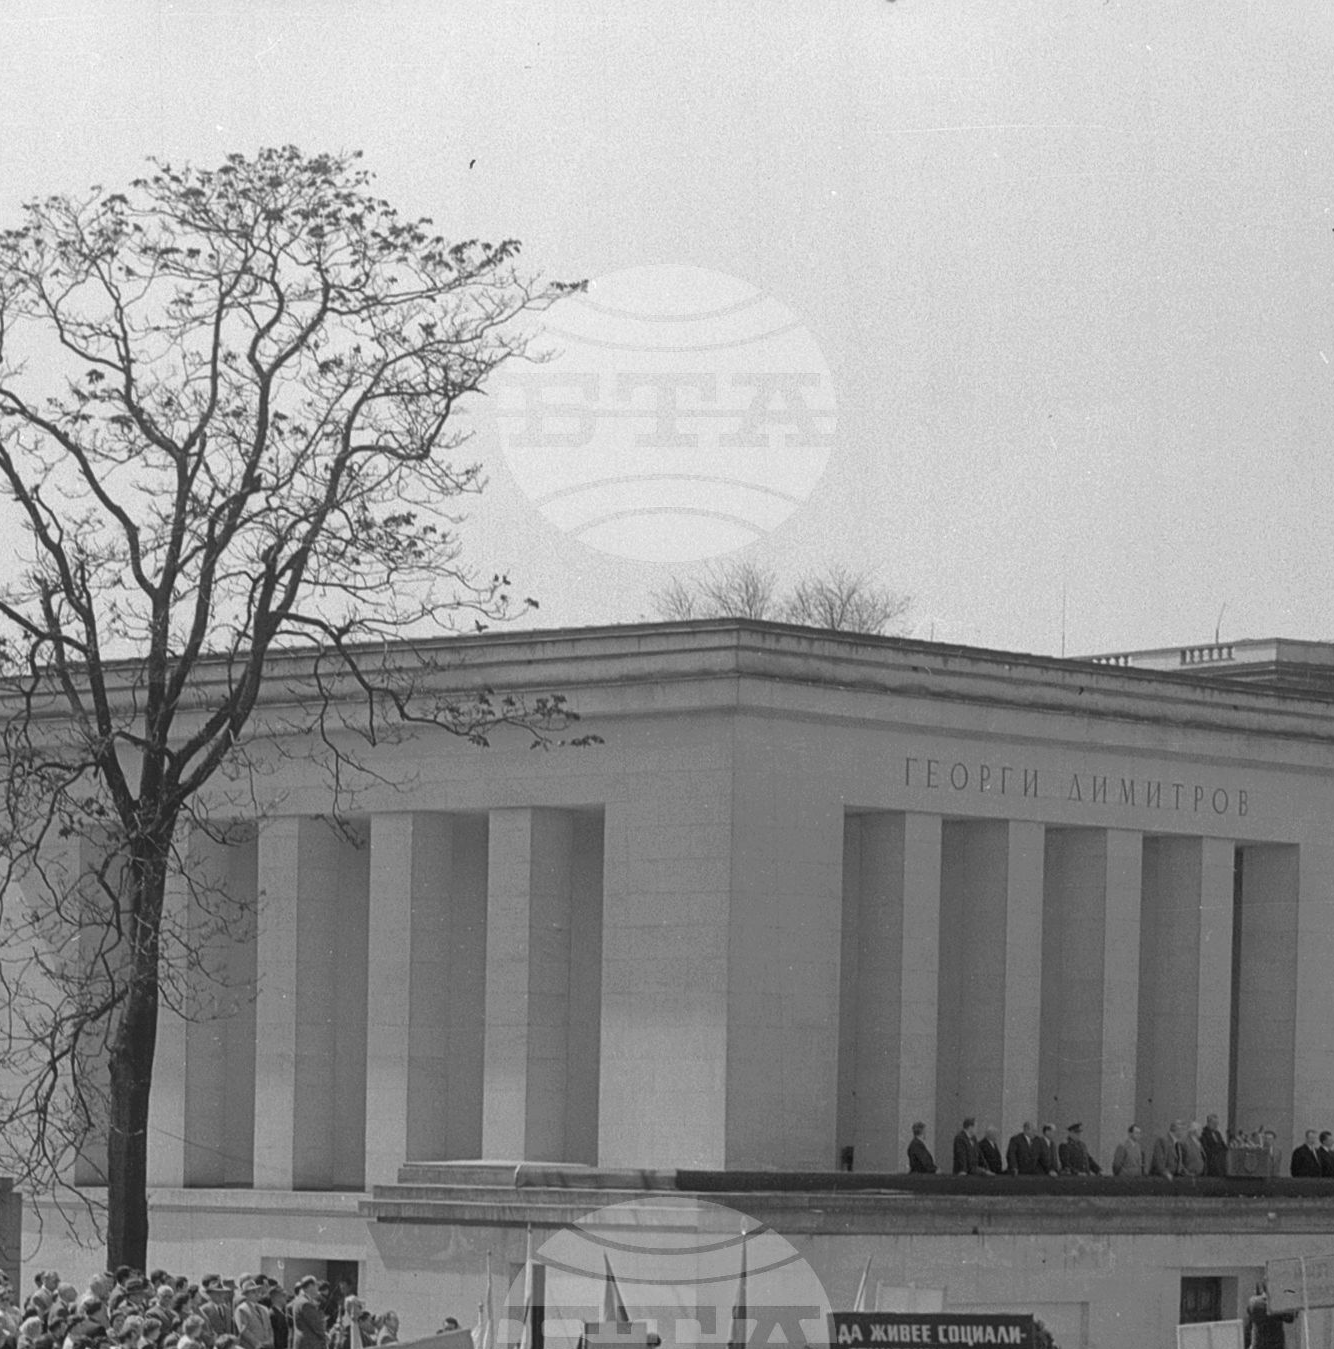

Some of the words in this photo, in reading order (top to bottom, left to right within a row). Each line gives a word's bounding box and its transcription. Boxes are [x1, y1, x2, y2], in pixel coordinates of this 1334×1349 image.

[904, 757, 1040, 799] ГЕОРГИ
[1067, 773, 1249, 817] ДИМИТРОВ
[837, 1323, 864, 1345] ДА
[870, 1324, 932, 1344] ЖИВЕЕ
[937, 1324, 1027, 1347] СОЦИАЛИ-
